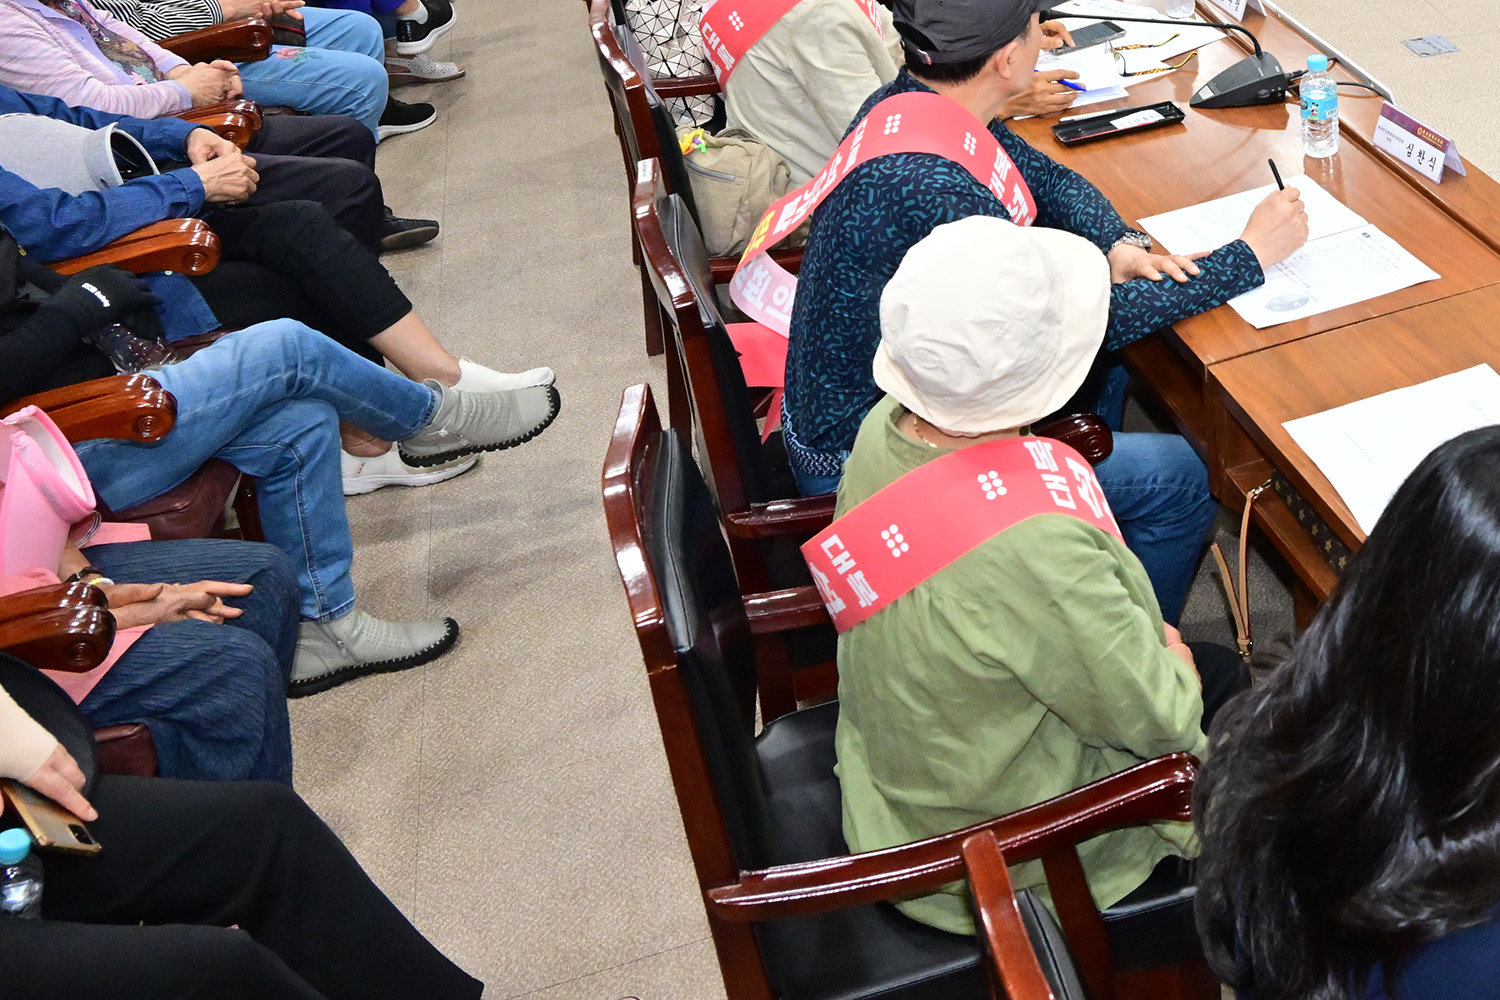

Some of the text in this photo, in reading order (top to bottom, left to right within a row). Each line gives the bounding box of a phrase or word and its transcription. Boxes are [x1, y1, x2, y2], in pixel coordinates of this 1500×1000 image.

[702, 22, 735, 71] 대복
[1406, 143, 1437, 172] 심찬식
[1023, 440, 1077, 510] 대복
[820, 534, 879, 608] 대복
